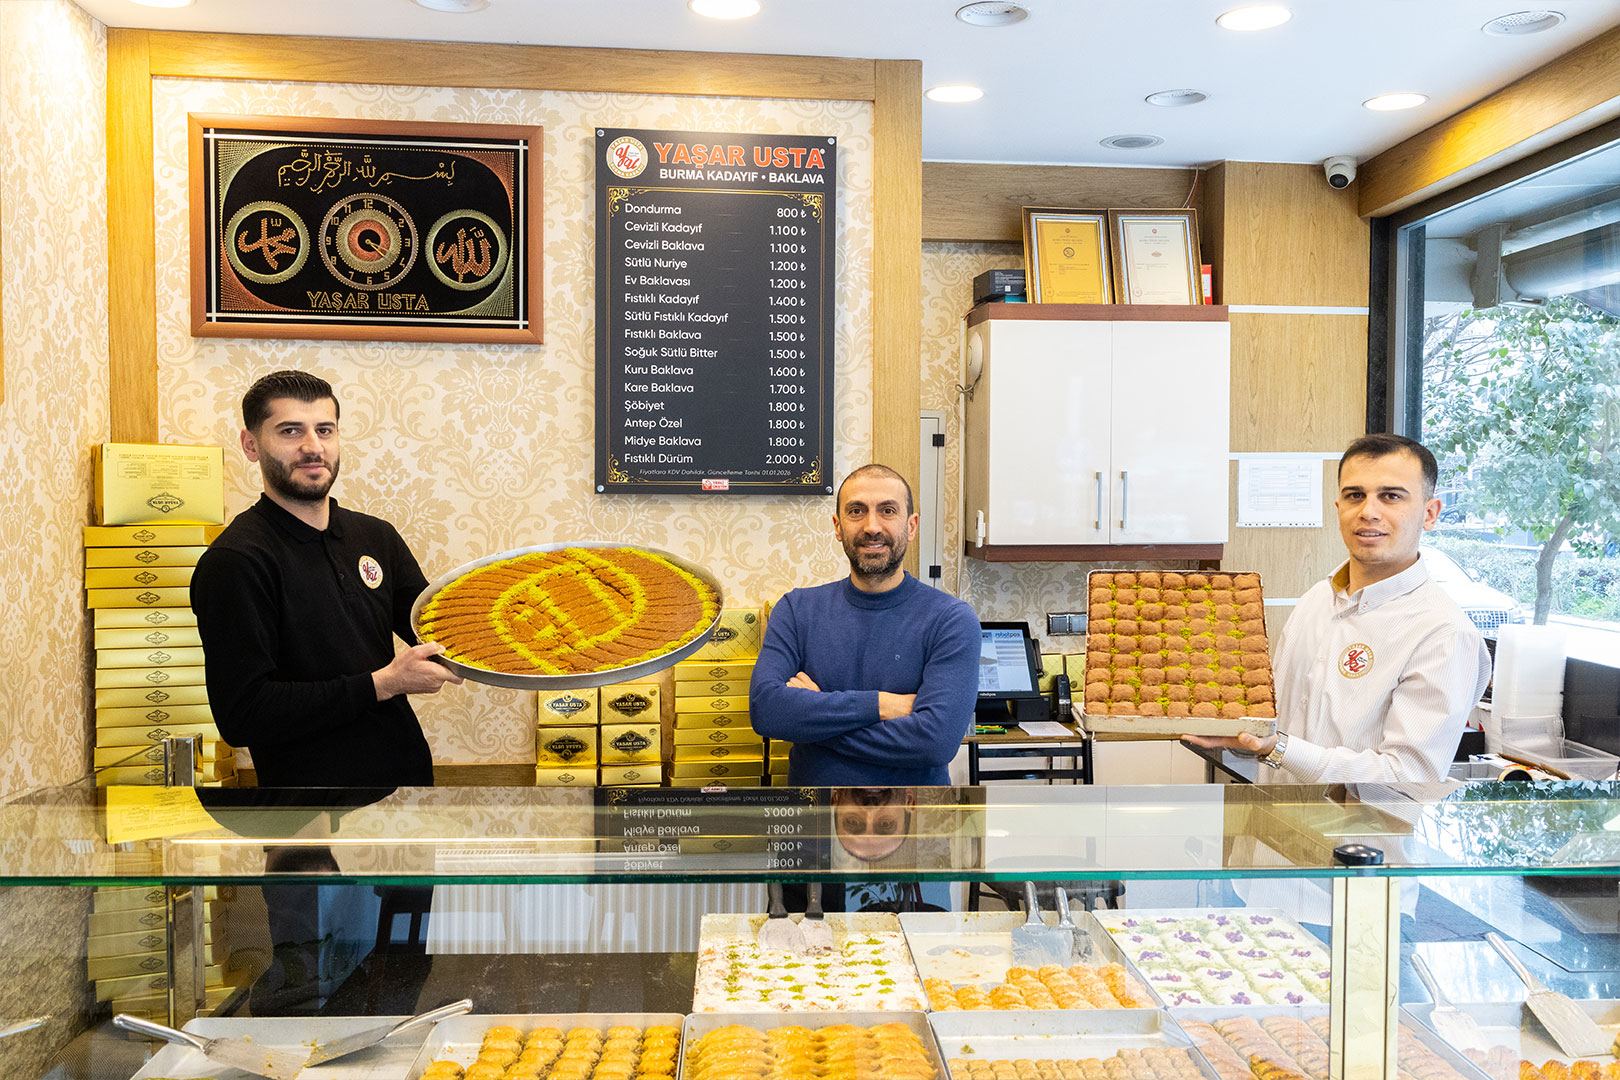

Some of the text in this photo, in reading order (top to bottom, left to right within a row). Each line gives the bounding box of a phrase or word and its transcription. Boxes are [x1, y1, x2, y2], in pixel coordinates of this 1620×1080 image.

[654, 143, 825, 168] YAŞAR USTA
[660, 169, 824, 183] BURMA KADAYIF BAKLAVA
[344, 204, 351, 213] 11
[363, 199, 373, 209] 12
[388, 205, 392, 213] 1
[625, 203, 681, 214] Dondurma
[777, 208, 798, 217] 800
[330, 217, 339, 225] 10
[398, 219, 405, 228] 2
[625, 221, 659, 231] Cevizli
[662, 223, 702, 235] Kadayıf
[770, 226, 798, 235] 1.100
[326, 236, 331, 245] 9
[404, 238, 410, 247] 3
[625, 239, 658, 249] Cevizli
[662, 240, 704, 250] Baklava
[770, 244, 798, 253] 1.100
[331, 256, 337, 265] 8
[399, 257, 406, 268] 4
[625, 257, 651, 267] Sütlü
[654, 258, 687, 270] Nuriye
[770, 261, 797, 271] 1.200
[348, 271, 354, 280] 7
[366, 276, 373, 285] 6
[384, 271, 390, 280] 5
[625, 275, 637, 284] Ev
[640, 276, 690, 286] Baklavası
[770, 279, 797, 288] 1.200
[306, 291, 430, 311] YAŞAR USTA
[625, 293, 655, 303] Fıstıklı
[659, 294, 699, 305] Kadayıf
[769, 297, 797, 306] 1.400
[625, 311, 651, 320] Sütlü
[654, 312, 685, 321] Fıstıklı
[688, 313, 728, 324] Kadayıf
[770, 314, 797, 324] 1.500
[625, 329, 655, 338] Fıstıklı
[659, 330, 701, 339] Baklava
[769, 332, 797, 341] 1.500
[625, 347, 657, 358] Soğuk
[661, 347, 687, 357] Sütlü
[690, 348, 718, 357] Bitter
[770, 350, 797, 359] 1.500
[625, 365, 647, 374] Kuru
[651, 365, 693, 375] Baklava
[769, 367, 797, 376] 1.600
[625, 383, 648, 392] Kare
[652, 383, 693, 392] Baklava
[770, 385, 797, 394] 1.700
[625, 400, 664, 412] Şöbiyet
[769, 402, 797, 411] 1.800
[625, 418, 656, 429] Antep
[659, 417, 682, 428] Özel
[769, 420, 796, 429] 1.800
[625, 436, 656, 447] Midye
[659, 436, 701, 445] Baklava
[769, 437, 796, 446] 1.800
[625, 454, 655, 463] Fıstıklı
[659, 454, 692, 463] Dürüm
[766, 455, 796, 464] 2.000
